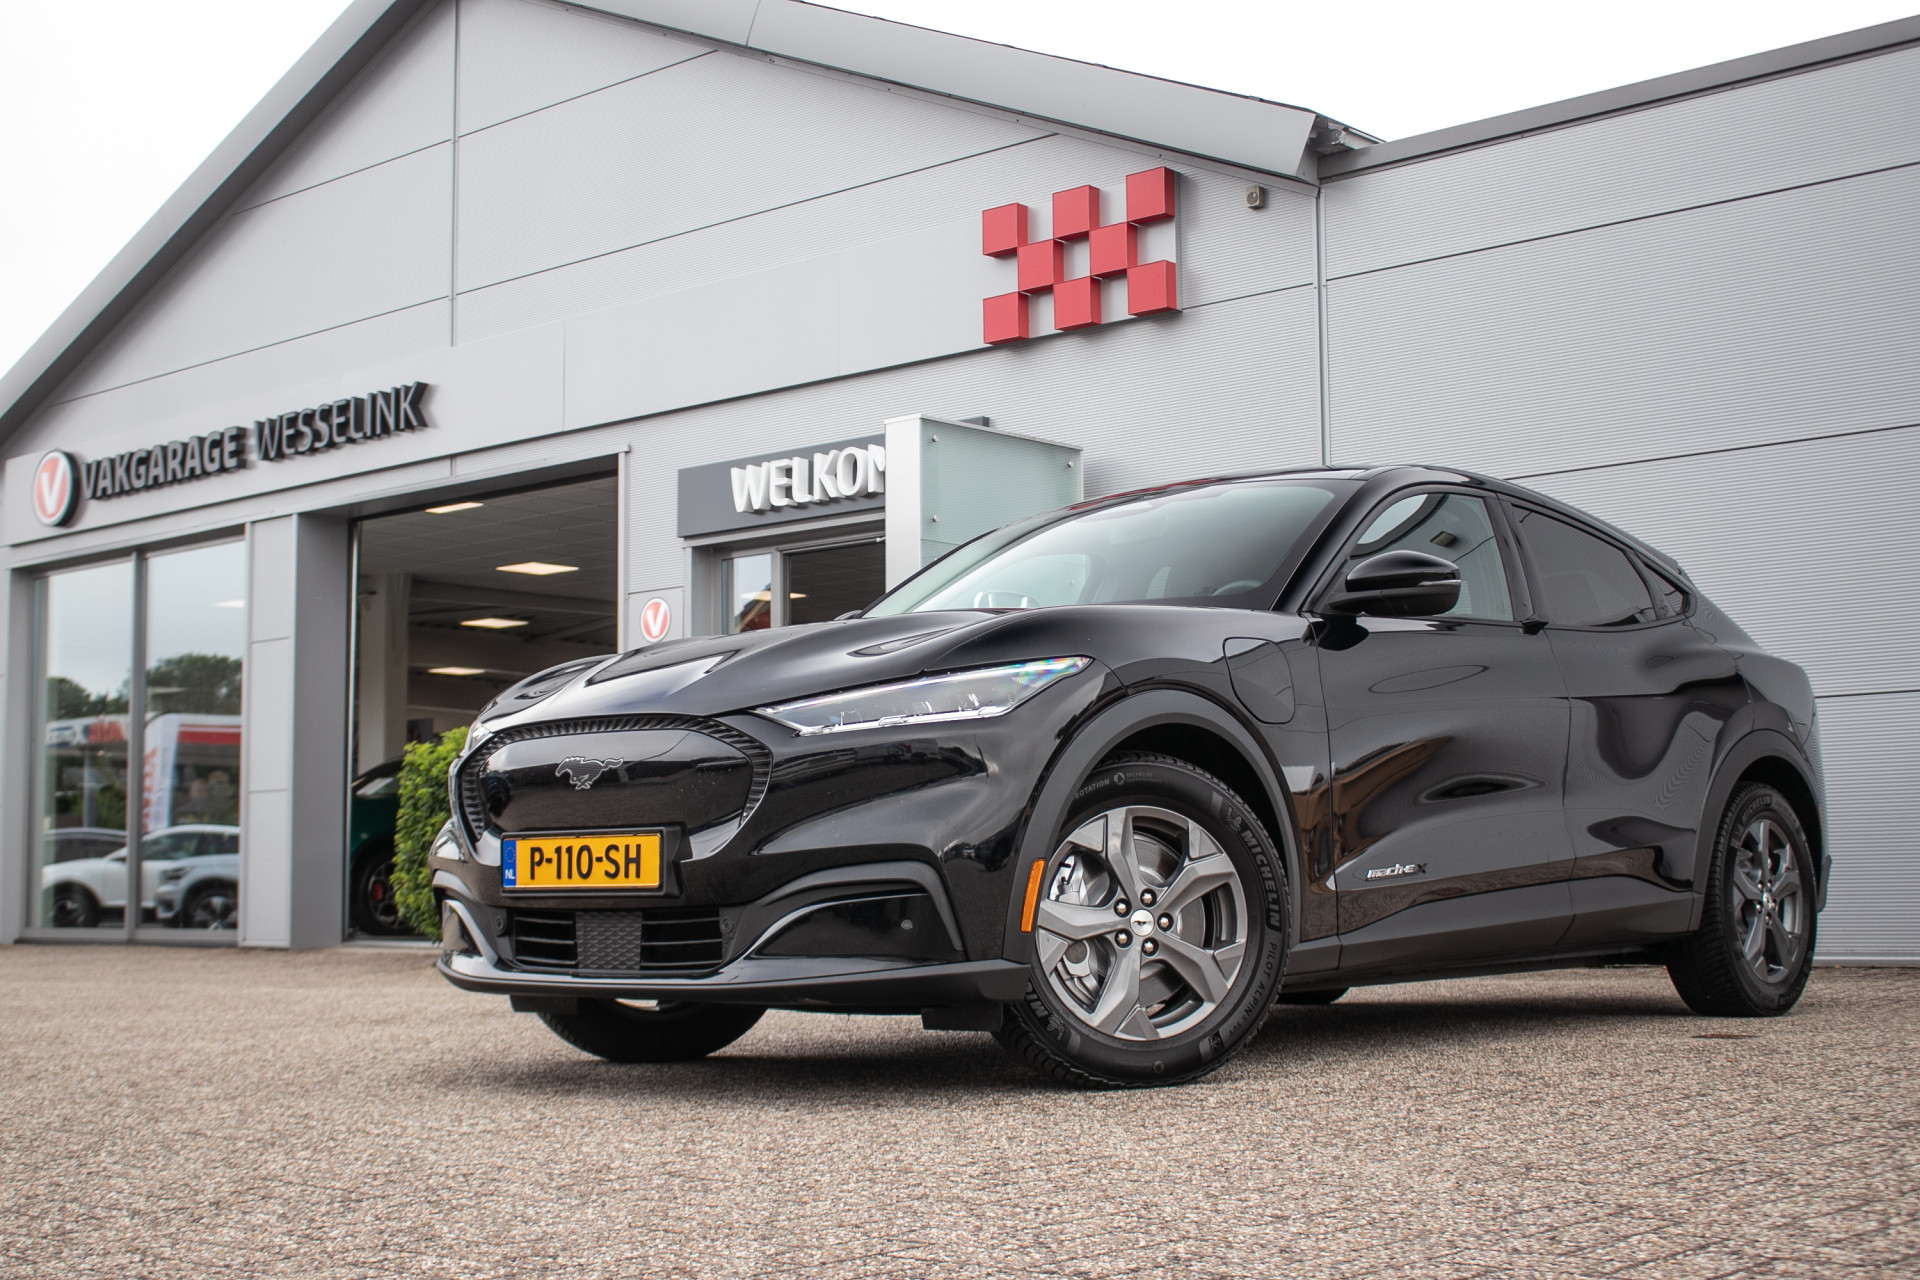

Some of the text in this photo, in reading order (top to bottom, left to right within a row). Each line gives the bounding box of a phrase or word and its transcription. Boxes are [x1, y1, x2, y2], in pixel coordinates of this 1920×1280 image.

[82, 382, 429, 499] VAKGARAGE WESSELINK
[505, 869, 515, 879] NL
[530, 843, 641, 880] P-110-SH
[1241, 829, 1282, 927] MICHELIN
[1265, 942, 1277, 978] PILOT
